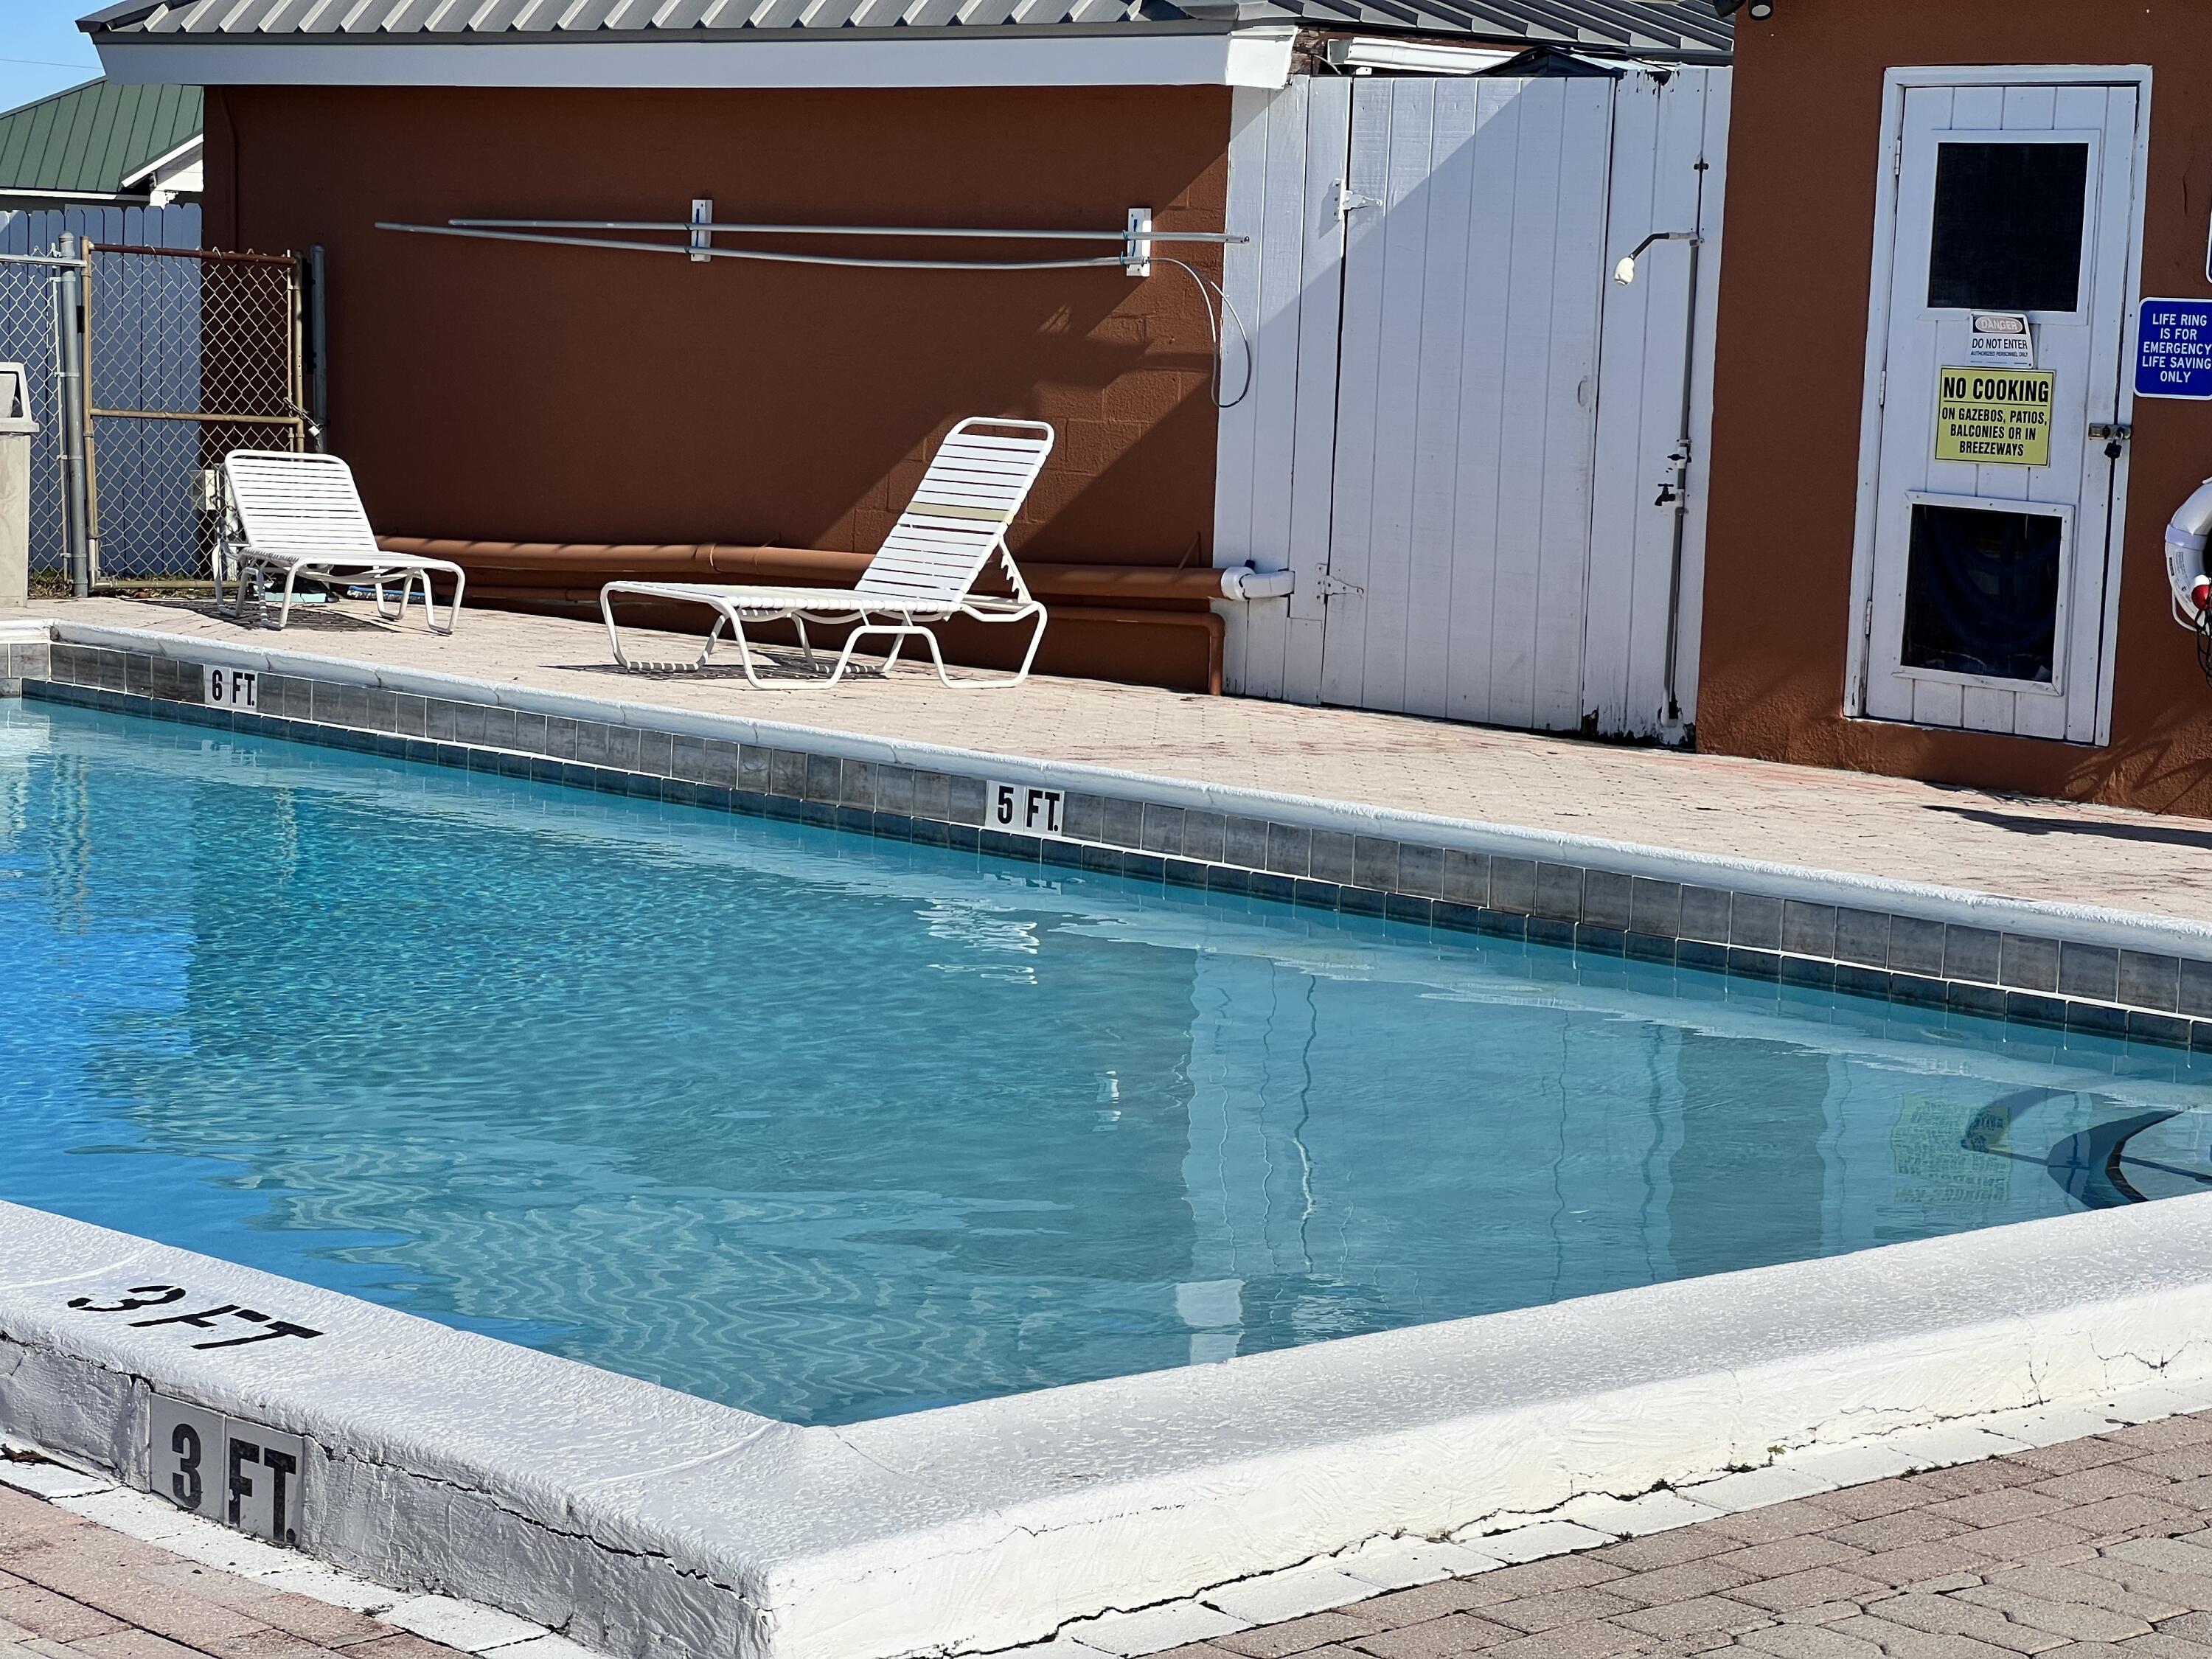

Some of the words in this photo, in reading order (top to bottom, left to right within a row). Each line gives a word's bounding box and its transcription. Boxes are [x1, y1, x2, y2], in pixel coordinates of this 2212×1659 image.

[1981, 319, 2018, 331] DANGER
[2152, 313, 2177, 325] LIFE
[2180, 314, 2208, 327] RING
[2160, 327, 2171, 339] IS
[2174, 328, 2197, 341] FOR
[1972, 338, 1984, 349] DO
[1986, 338, 2002, 349] NOT
[2003, 338, 2028, 350] ENTER
[2143, 341, 2212, 355] EMERGENCY
[2142, 355, 2166, 368] LIFE
[2169, 356, 2212, 369] SAVING
[2160, 370, 2191, 383] ONLY
[1943, 377, 1966, 399] NO
[1972, 378, 2049, 403] COOKING
[1941, 407, 1955, 420] ON
[1958, 408, 2006, 424] GAZEBOS,
[2009, 410, 2048, 426] PATIOS,
[1950, 424, 2005, 439] BALCONIES
[2008, 426, 2022, 440] OR
[2025, 428, 2036, 441] IN
[1959, 440, 2024, 456] BREEZEWAYS
[212, 669, 223, 701] 6
[232, 671, 255, 706] FT.
[997, 785, 1014, 824] 5
[1026, 789, 1060, 832] FT.
[67, 1284, 187, 1312] 3
[127, 1304, 324, 1350] FT
[171, 1423, 202, 1510] 3
[229, 1436, 296, 1545] FT.
